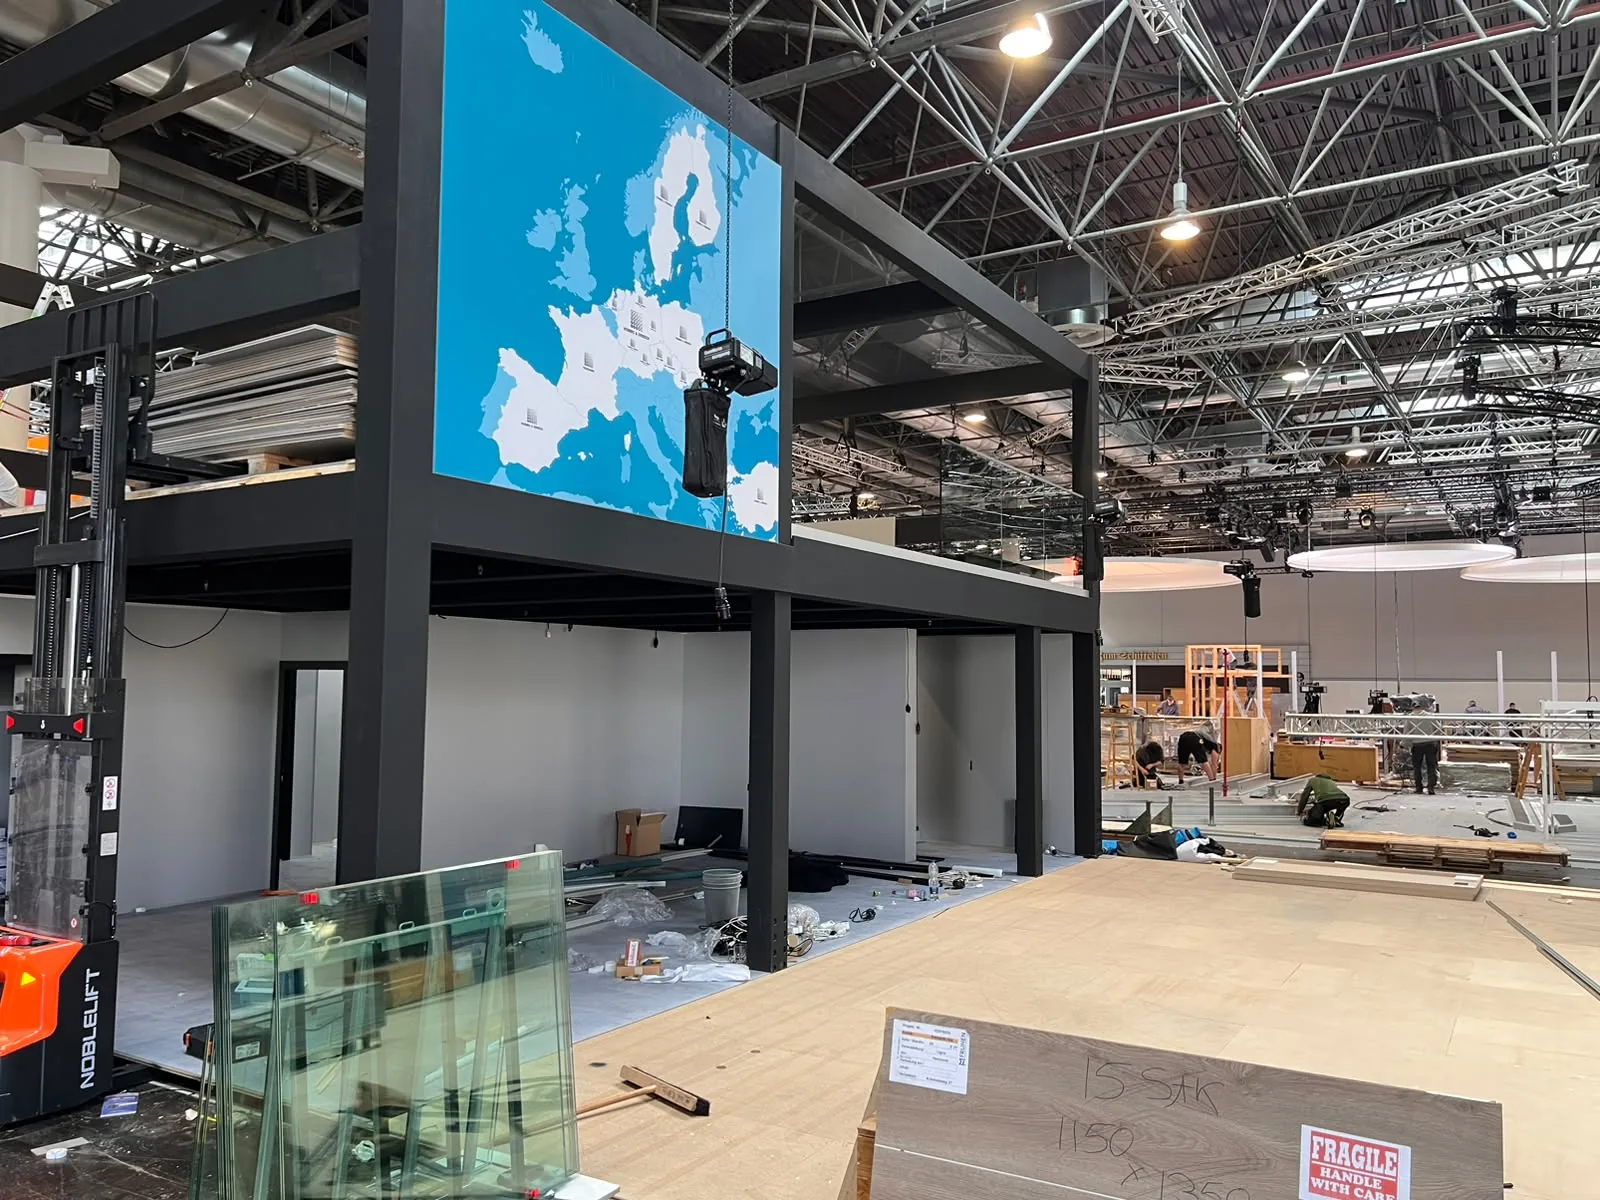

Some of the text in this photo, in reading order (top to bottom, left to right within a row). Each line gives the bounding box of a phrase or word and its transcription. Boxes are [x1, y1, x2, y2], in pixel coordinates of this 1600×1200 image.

[80, 968, 100, 1089] NOBLELIFT
[1059, 1116, 1134, 1157] 1150
[1311, 1135, 1397, 1177] FRAGILE
[1310, 1177, 1350, 1195] WITH
[1320, 1167, 1382, 1190] HANDLE
